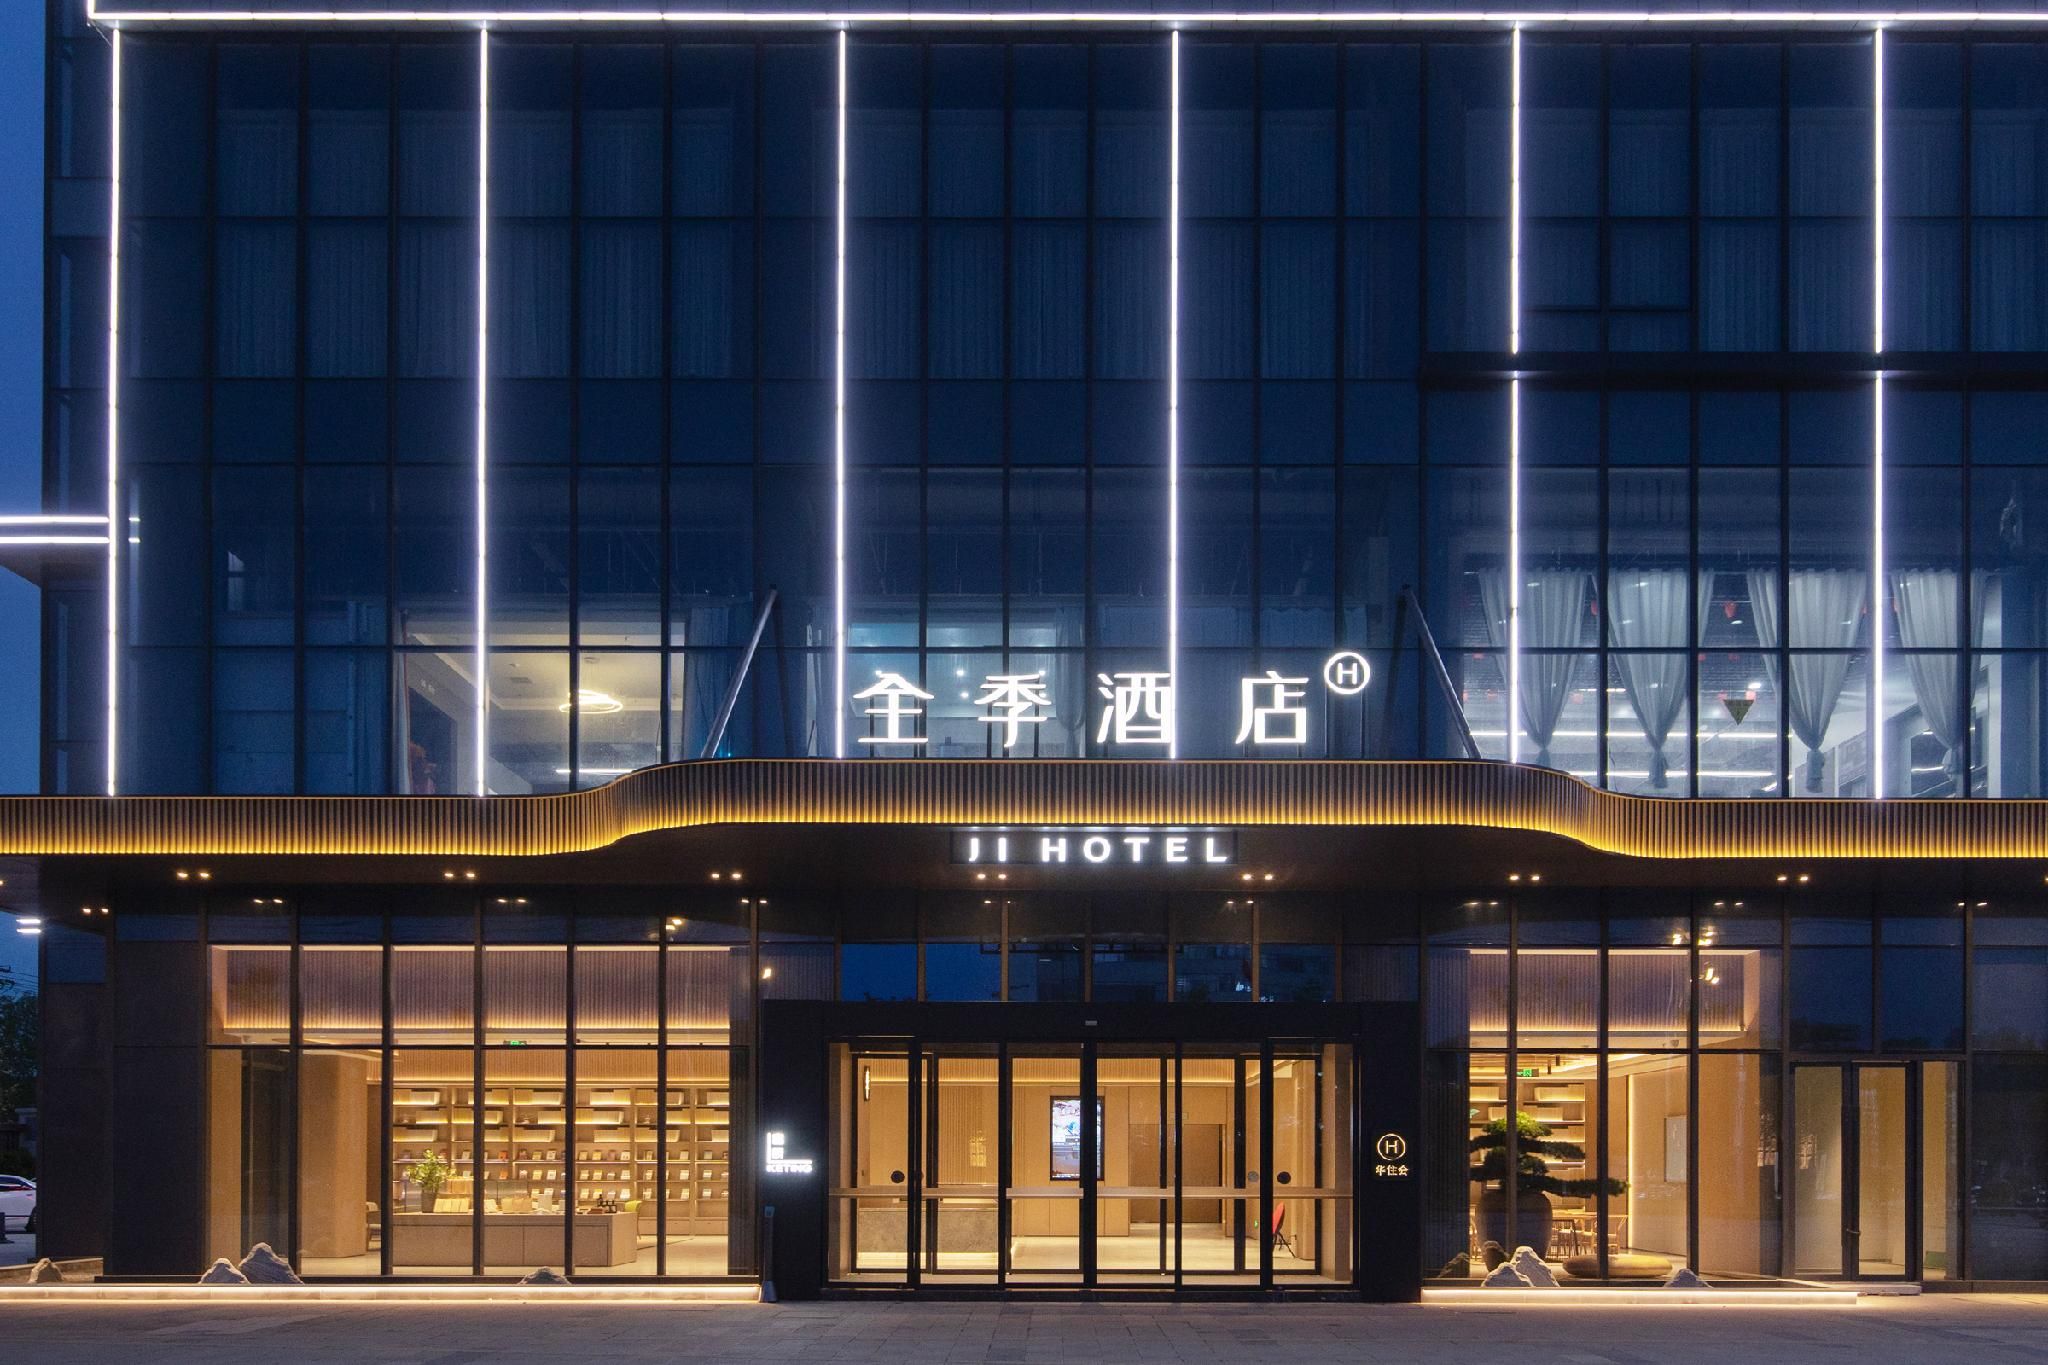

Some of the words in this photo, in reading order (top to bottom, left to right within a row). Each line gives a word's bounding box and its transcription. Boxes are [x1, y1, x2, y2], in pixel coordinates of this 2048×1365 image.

[853, 671, 1309, 747] 全季酒店
[968, 837, 1007, 863] JI
[1041, 837, 1229, 863] HOTEL
